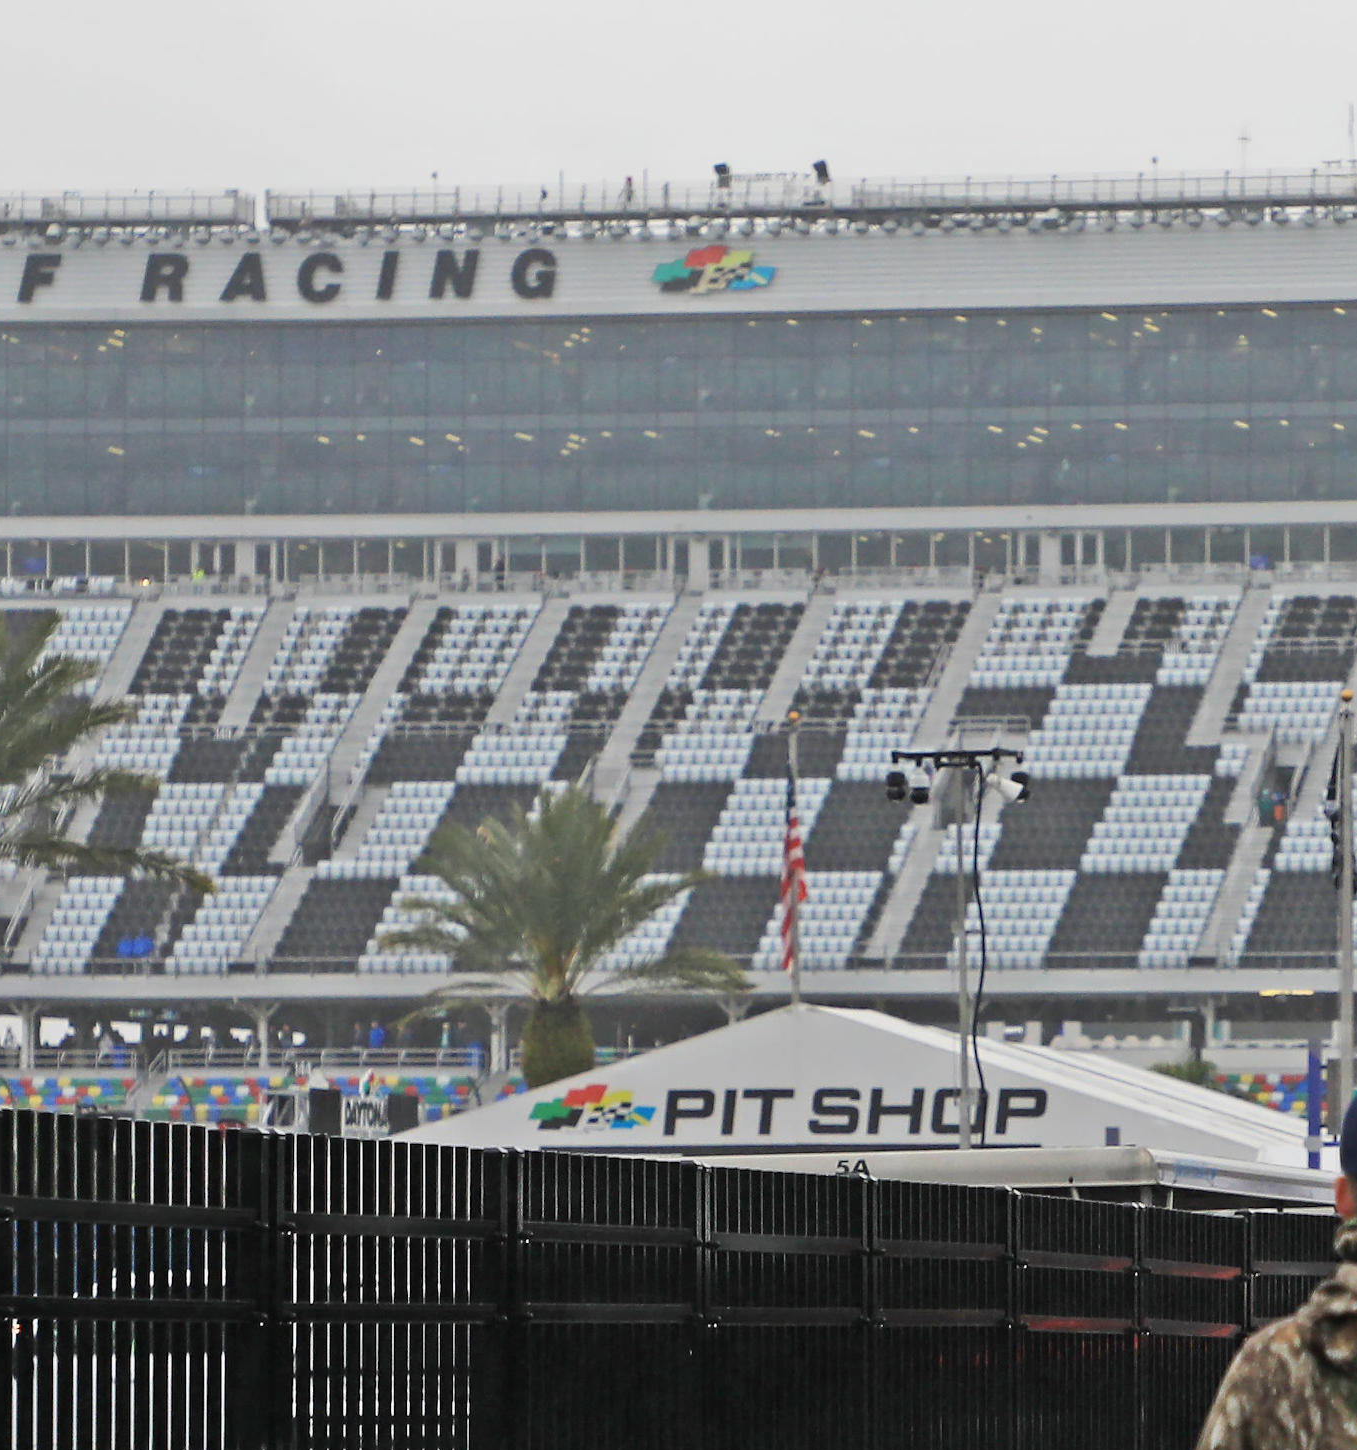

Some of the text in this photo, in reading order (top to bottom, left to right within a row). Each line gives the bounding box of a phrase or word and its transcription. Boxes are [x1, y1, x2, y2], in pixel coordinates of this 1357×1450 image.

[139, 248, 558, 304] RACING
[663, 1088, 1048, 1135] PIT SHOP
[836, 1158, 870, 1177] 5A
